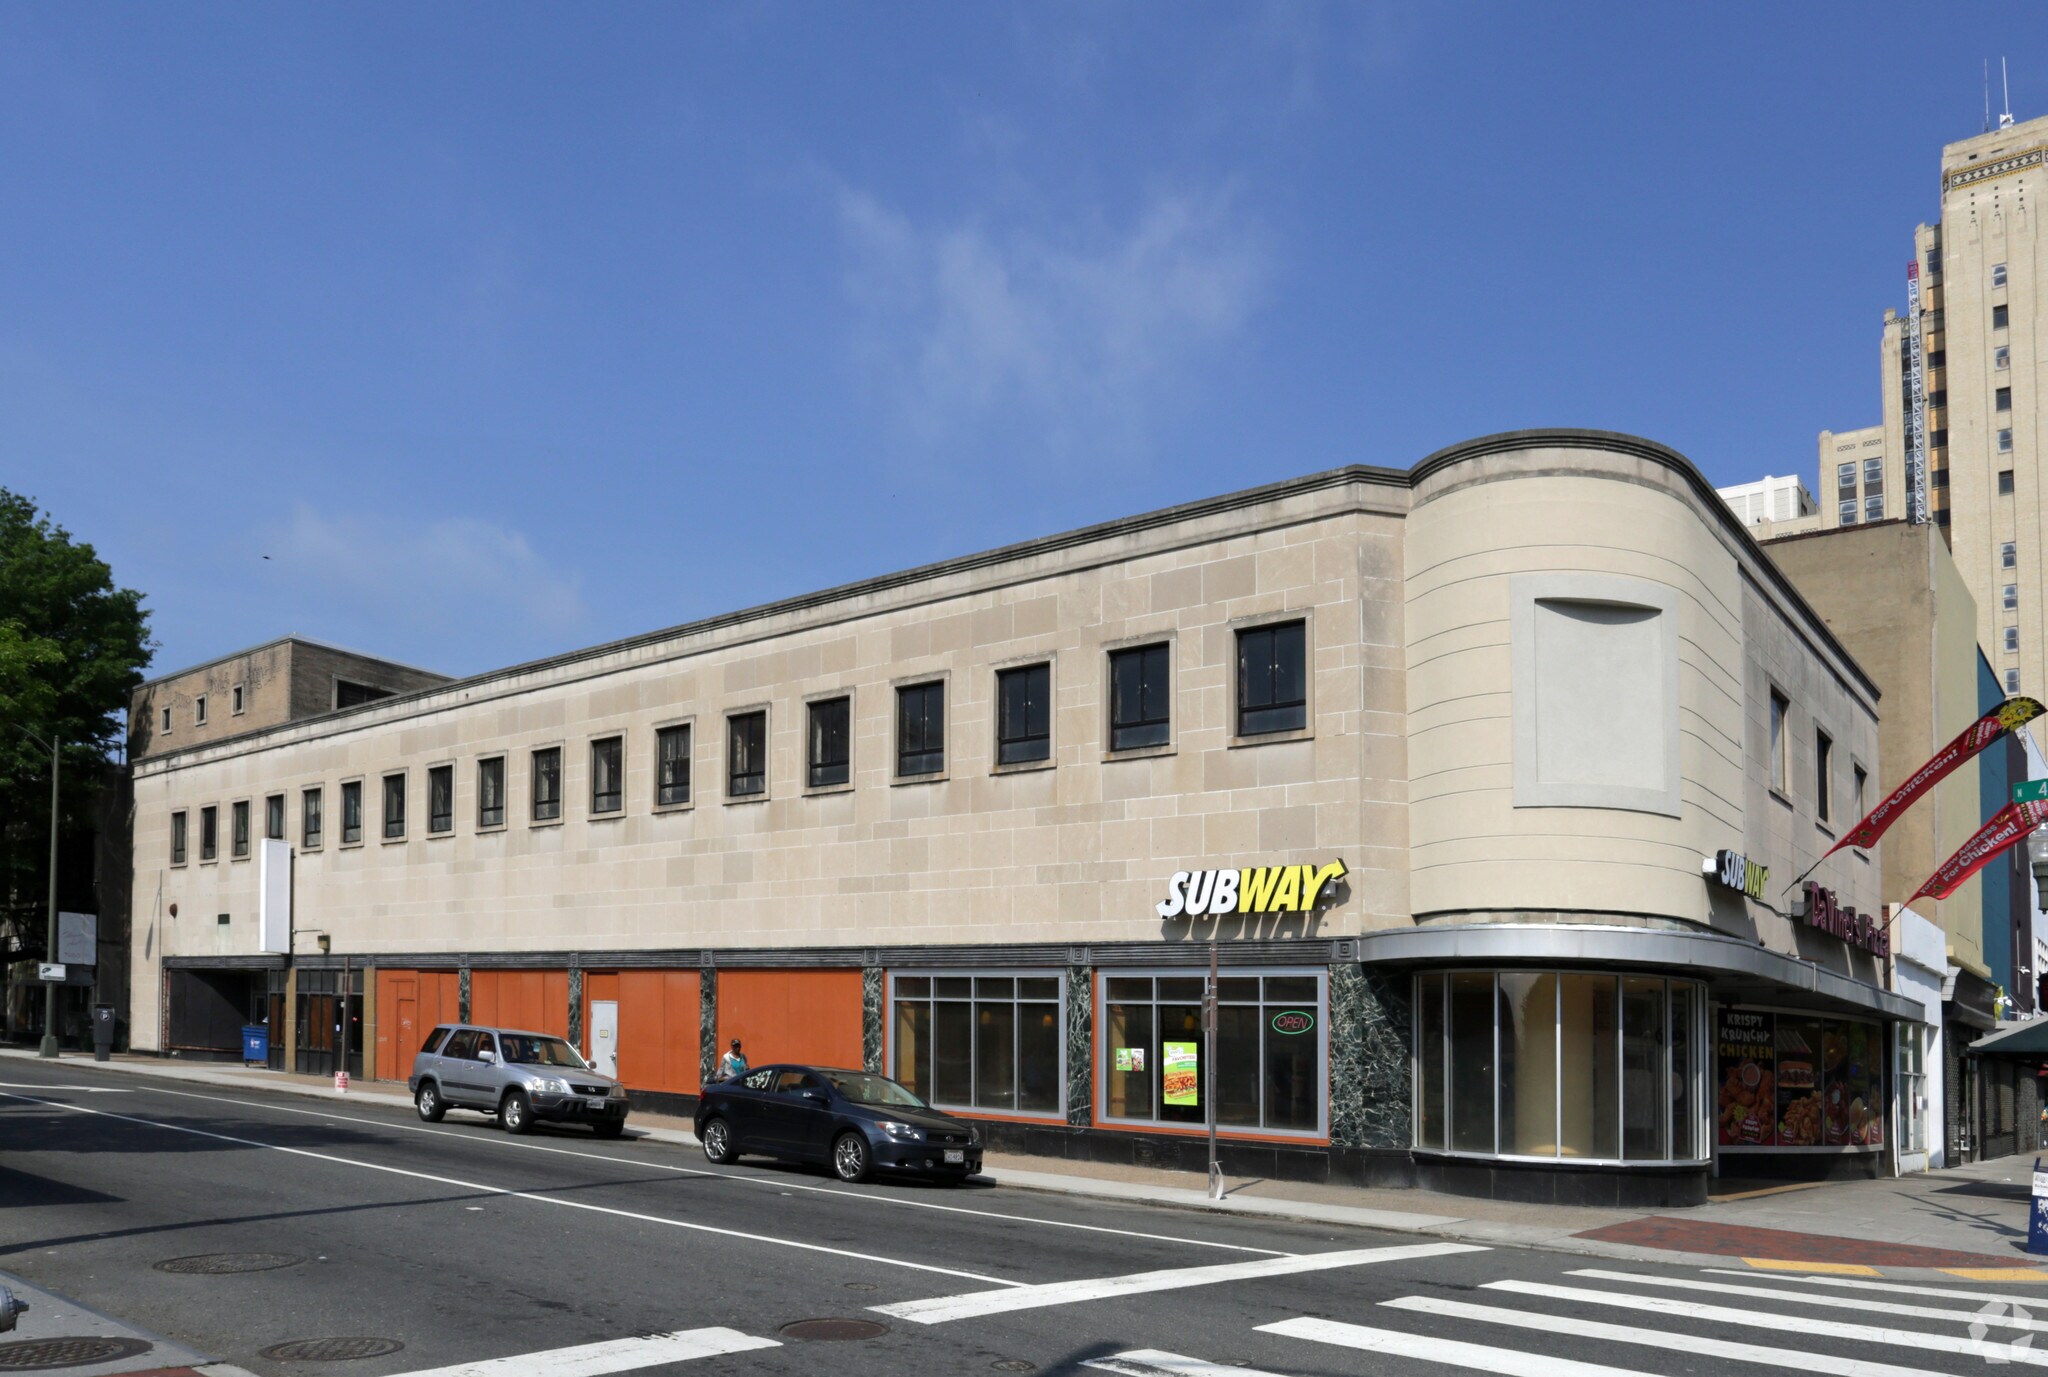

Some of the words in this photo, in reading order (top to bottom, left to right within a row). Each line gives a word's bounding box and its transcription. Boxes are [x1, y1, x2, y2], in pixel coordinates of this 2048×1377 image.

[2017, 788, 2022, 798] N
[1959, 824, 1998, 857] Address
[1942, 866, 1961, 882] For
[1959, 821, 2018, 867] Chicken!
[1721, 849, 1770, 901] SUBWAY
[1154, 858, 1346, 920] SUBWAY
[1277, 1016, 1308, 1029] OPEN
[1727, 1013, 1763, 1027] KRISPY
[1721, 1026, 1770, 1042] KRUNCHY
[1719, 1043, 1774, 1059] CHICKEN
